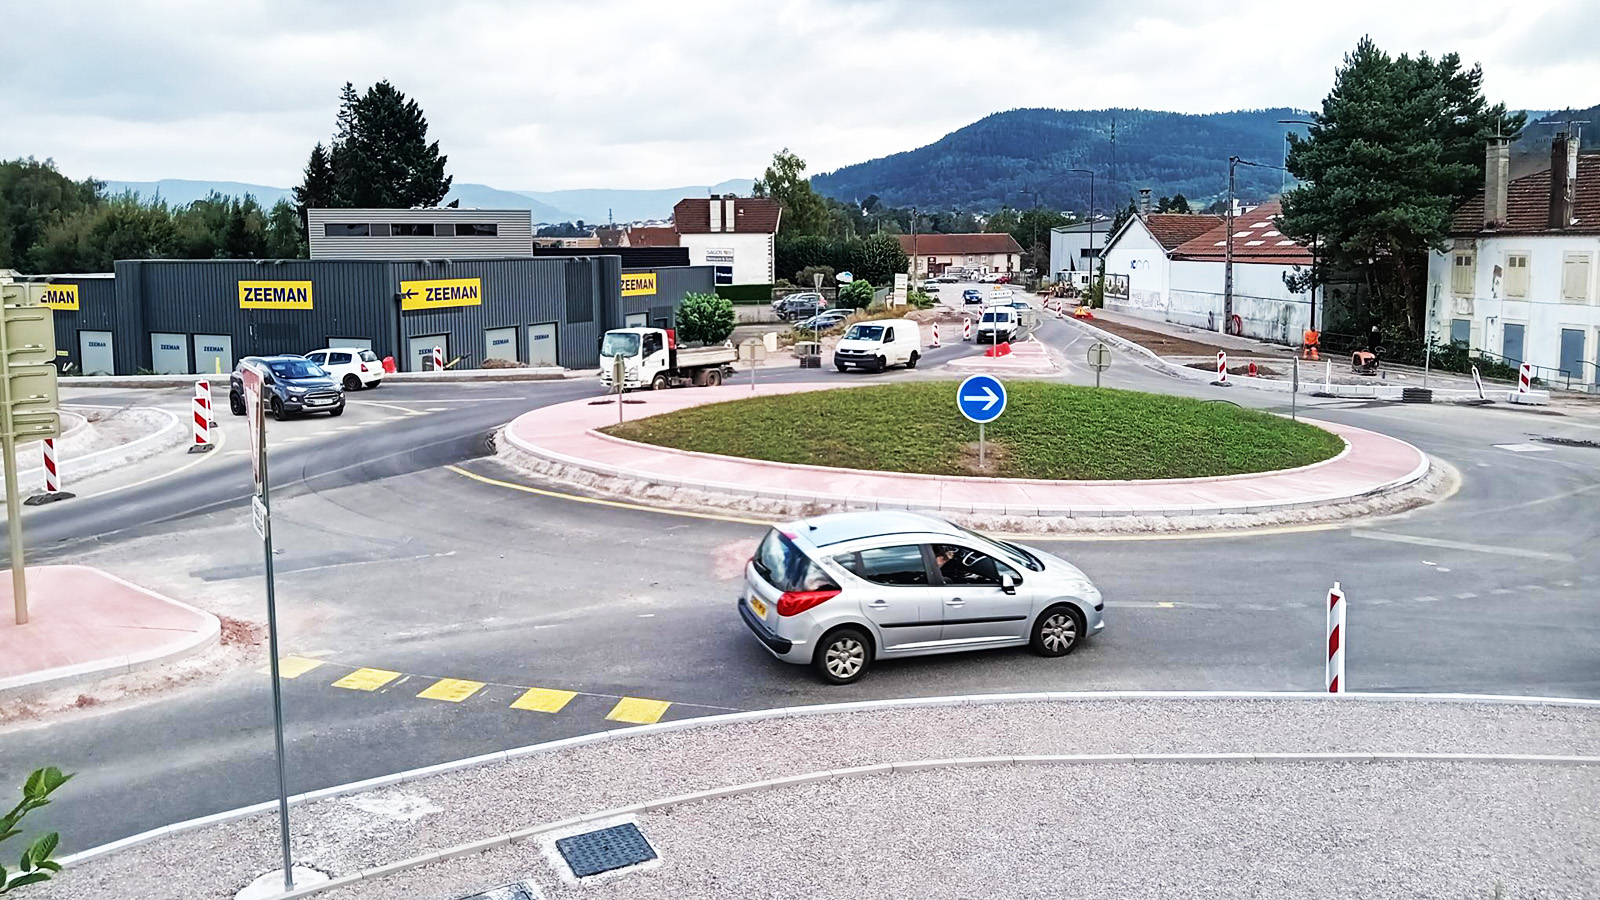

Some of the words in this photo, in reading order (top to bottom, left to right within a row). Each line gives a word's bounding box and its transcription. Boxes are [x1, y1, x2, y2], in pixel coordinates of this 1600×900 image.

[621, 278, 654, 291] ZEEMAN
[40, 290, 75, 304] EMAN
[243, 287, 308, 303] ZEEMAN
[425, 285, 478, 302] ZEEMAN
[492, 338, 510, 346] ZEEMAN
[533, 333, 550, 341] ZEEMAN
[418, 347, 434, 356] ZEEM
